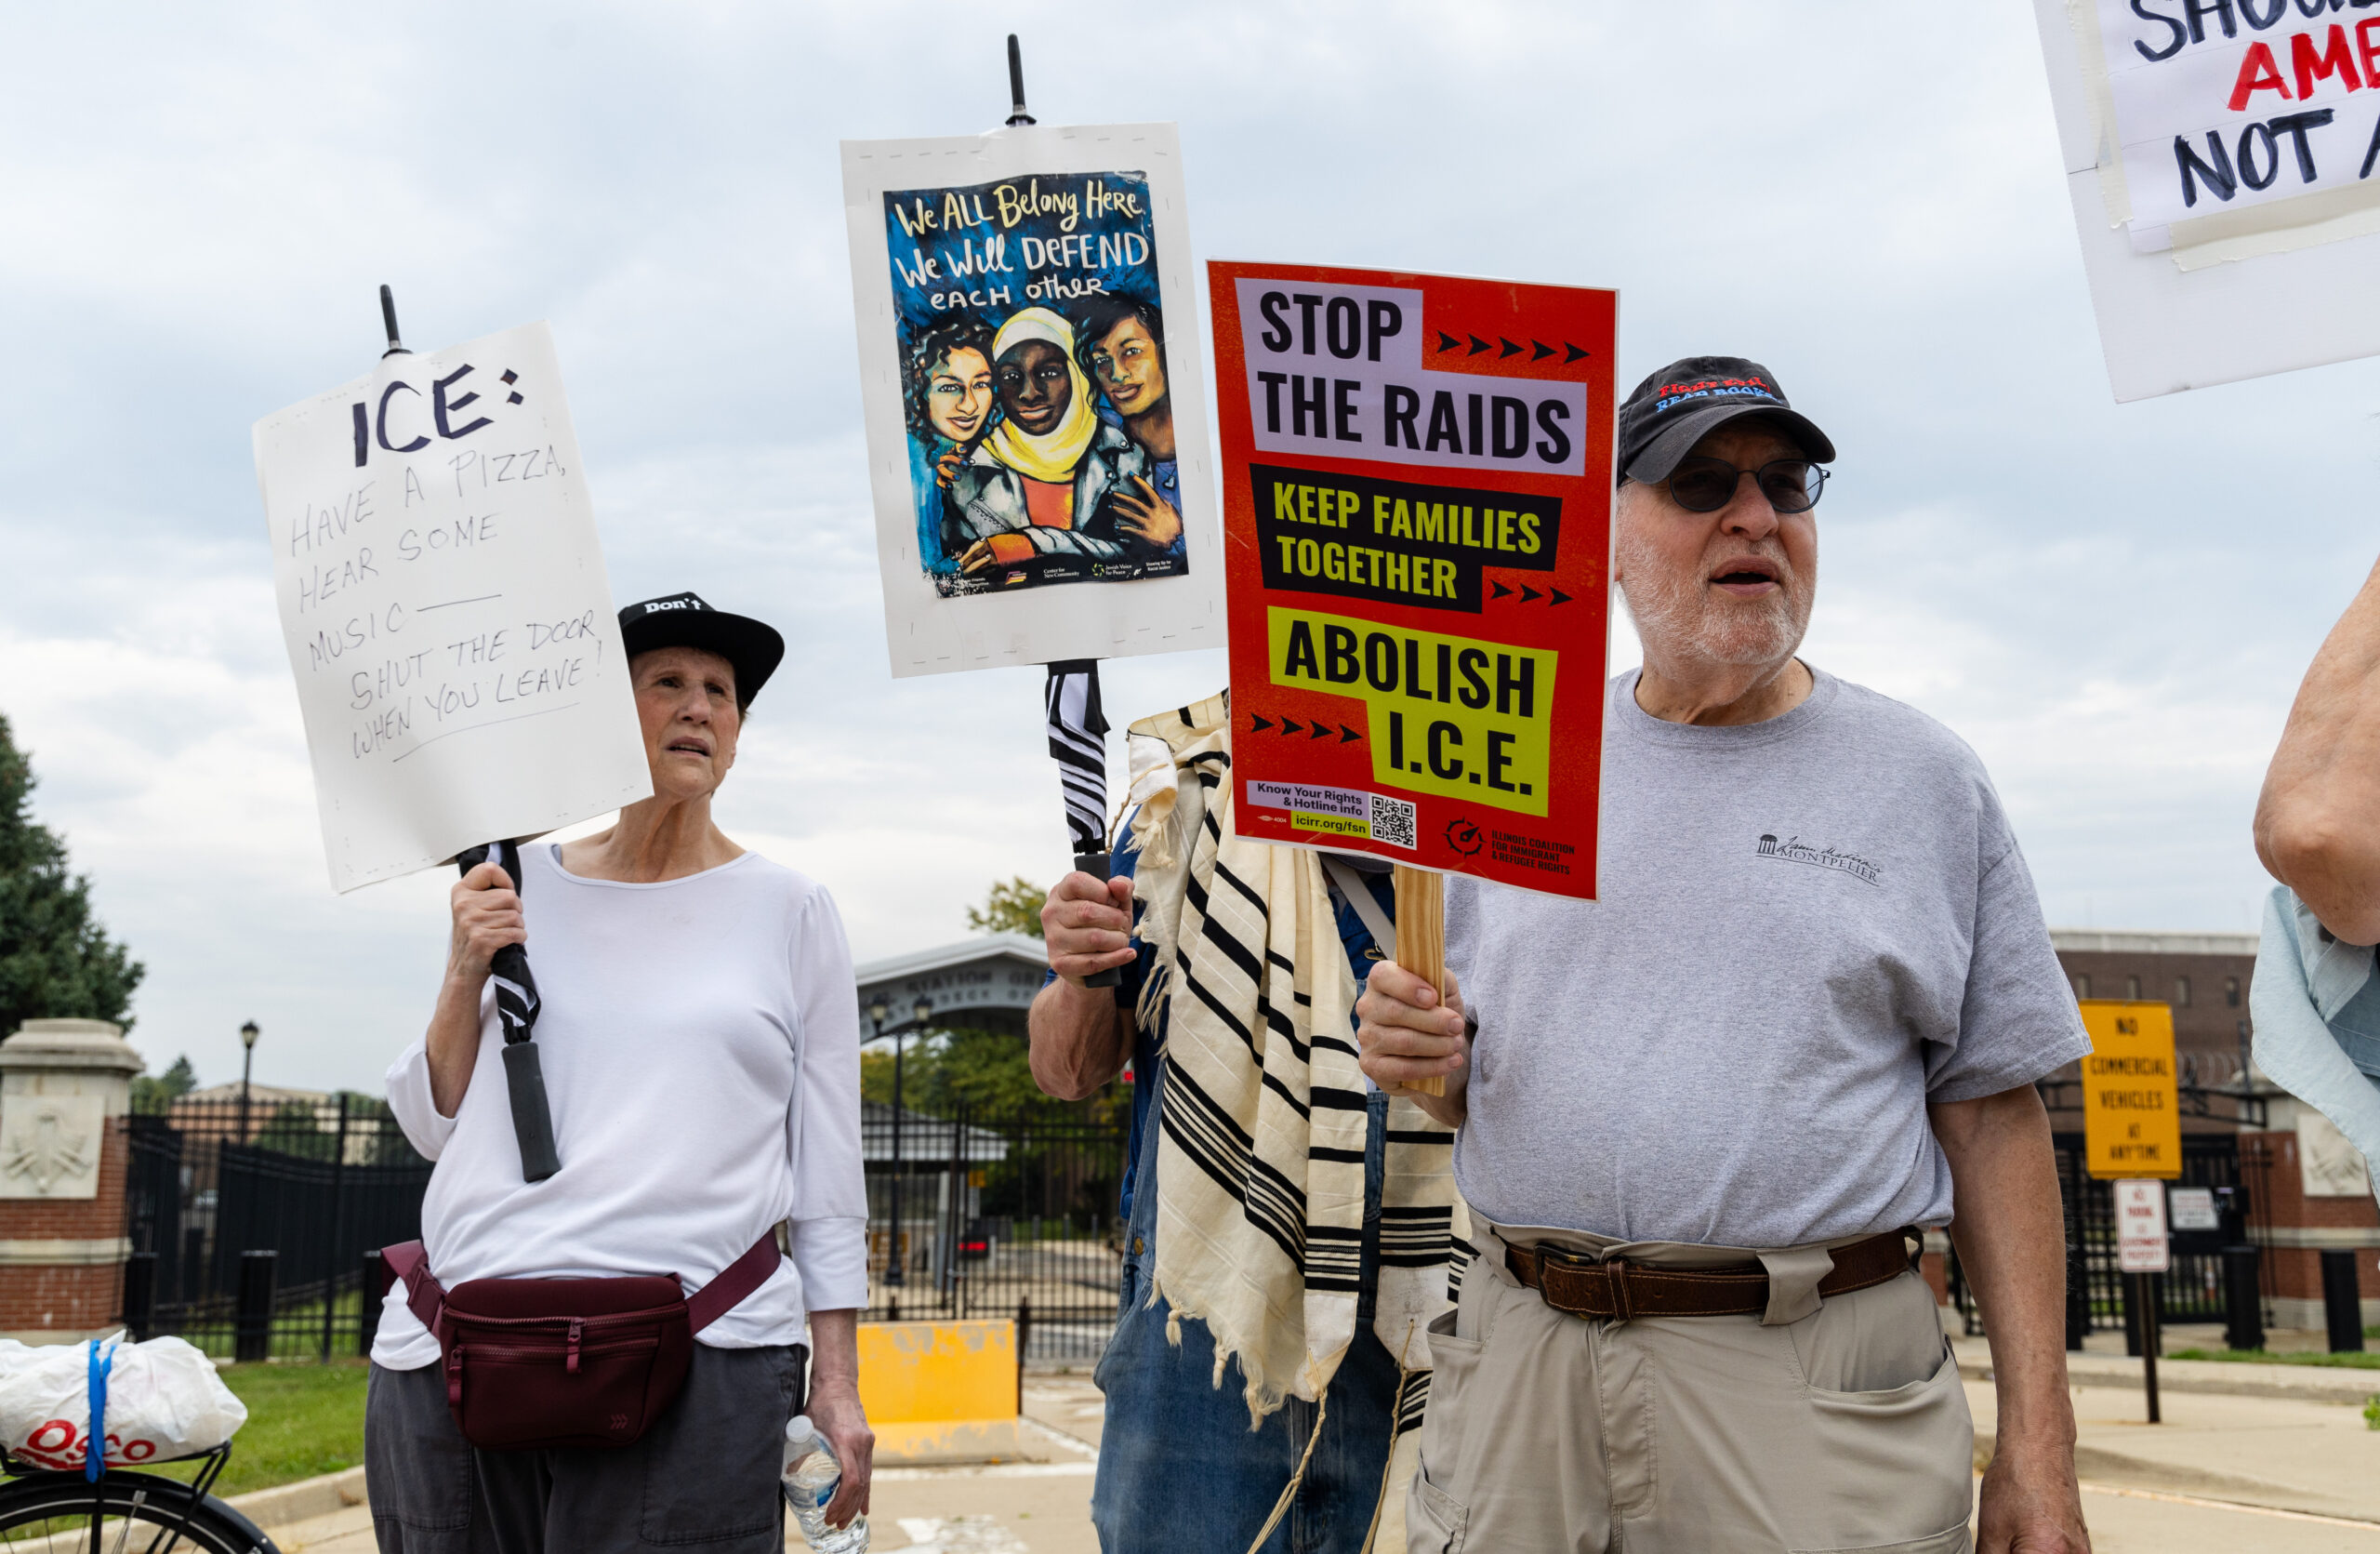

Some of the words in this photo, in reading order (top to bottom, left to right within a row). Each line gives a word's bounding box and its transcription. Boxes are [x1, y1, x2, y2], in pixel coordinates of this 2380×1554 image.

[2174, 108, 2334, 207] NOT
[894, 197, 938, 237] We
[944, 192, 994, 231] ALL
[894, 248, 941, 288] We
[945, 233, 1013, 279] Will
[1260, 291, 1403, 362] STOP
[352, 364, 524, 468] ICE:
[1257, 371, 1362, 443] THE
[1383, 384, 1571, 464] RAIDS
[1656, 388, 1710, 413] READ
[292, 481, 376, 557] HAVE
[405, 466, 424, 508] A
[448, 445, 565, 497] PIZZA,
[1274, 482, 1360, 528] KEEP
[1373, 496, 1540, 554] FAMILIES
[300, 547, 378, 614] HEAR
[398, 513, 501, 561] SOME
[1277, 535, 1457, 599] TOGETHER
[644, 597, 701, 614] Don't
[309, 603, 402, 671] MUSIC
[350, 649, 433, 711] SHUT
[447, 630, 509, 667] THE
[526, 610, 595, 650] DOOR
[1284, 619, 1535, 718] ABOLISH
[353, 697, 411, 758] WHEN
[425, 683, 480, 722] YOU
[1389, 711, 1532, 795] I.C.E.
[1257, 783, 1291, 795] Know
[1295, 787, 1322, 799] Your
[1325, 790, 1362, 805] Rights
[1283, 797, 1291, 806] &
[1294, 798, 1338, 812] Hotline
[1340, 802, 1363, 817] info
[1296, 815, 1366, 834] icirr.org/fsn
[1492, 830, 1527, 846] ILLINOIS
[1529, 838, 1575, 855] COALITION
[1492, 841, 1507, 852] FOR
[1511, 844, 1560, 863] IMMIGRANT
[1491, 850, 1498, 860] &
[1499, 852, 1536, 869] REFUGEE
[1538, 860, 1570, 875] RIGHTS
[1779, 848, 1877, 883] MONTPELIER
[2115, 1016, 2138, 1036] NO
[2090, 1056, 2168, 1077] COMMERCIAL
[2099, 1090, 2164, 1110] VEHICLES
